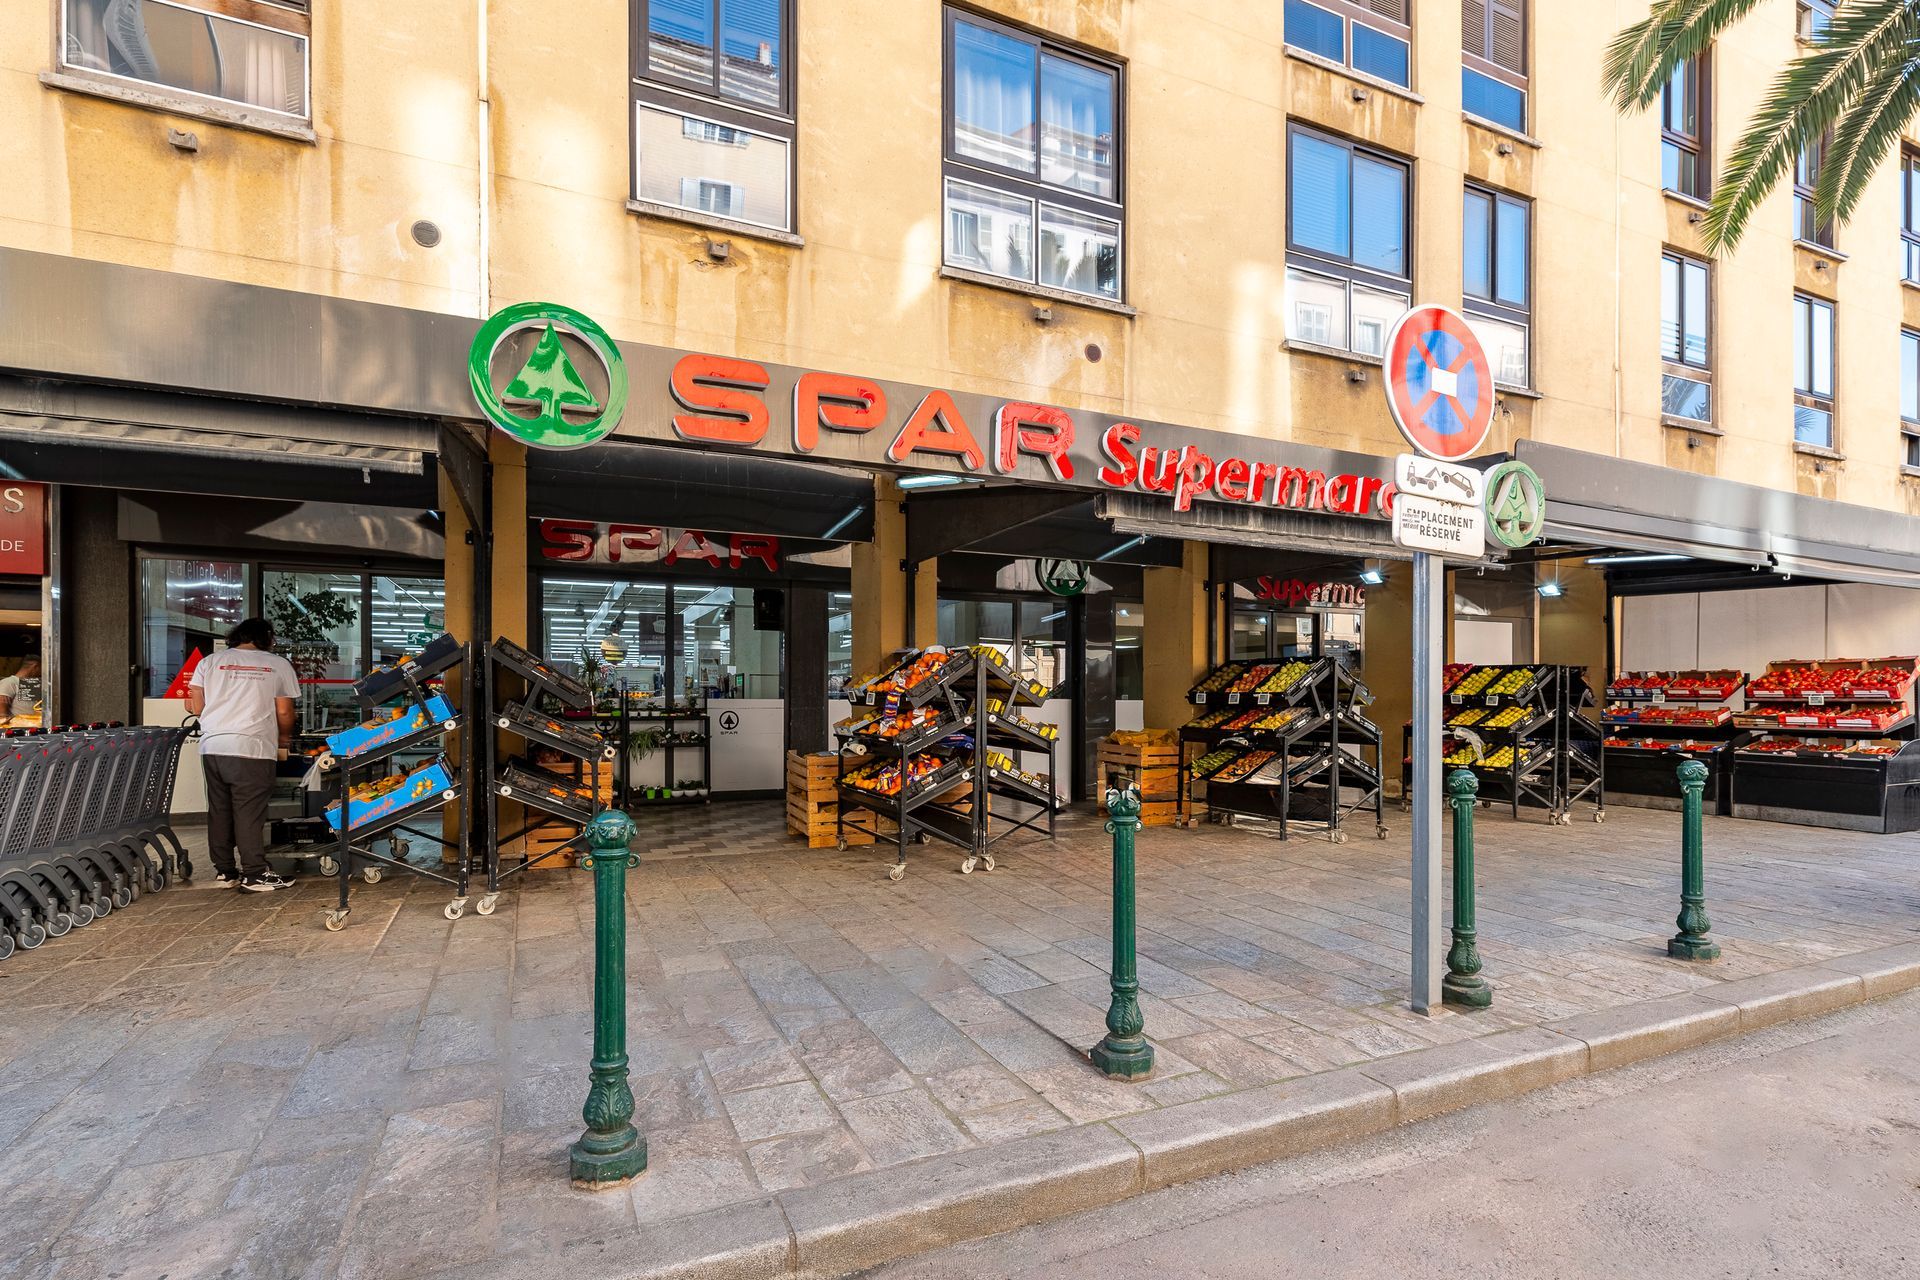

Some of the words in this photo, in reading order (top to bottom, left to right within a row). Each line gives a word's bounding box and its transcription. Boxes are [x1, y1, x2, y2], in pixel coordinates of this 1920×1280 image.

[669, 354, 1076, 481] SPAR
[1, 539, 25, 552] DE
[540, 518, 779, 573] SPAR
[1419, 524, 1461, 541] RÉSERVÉ
